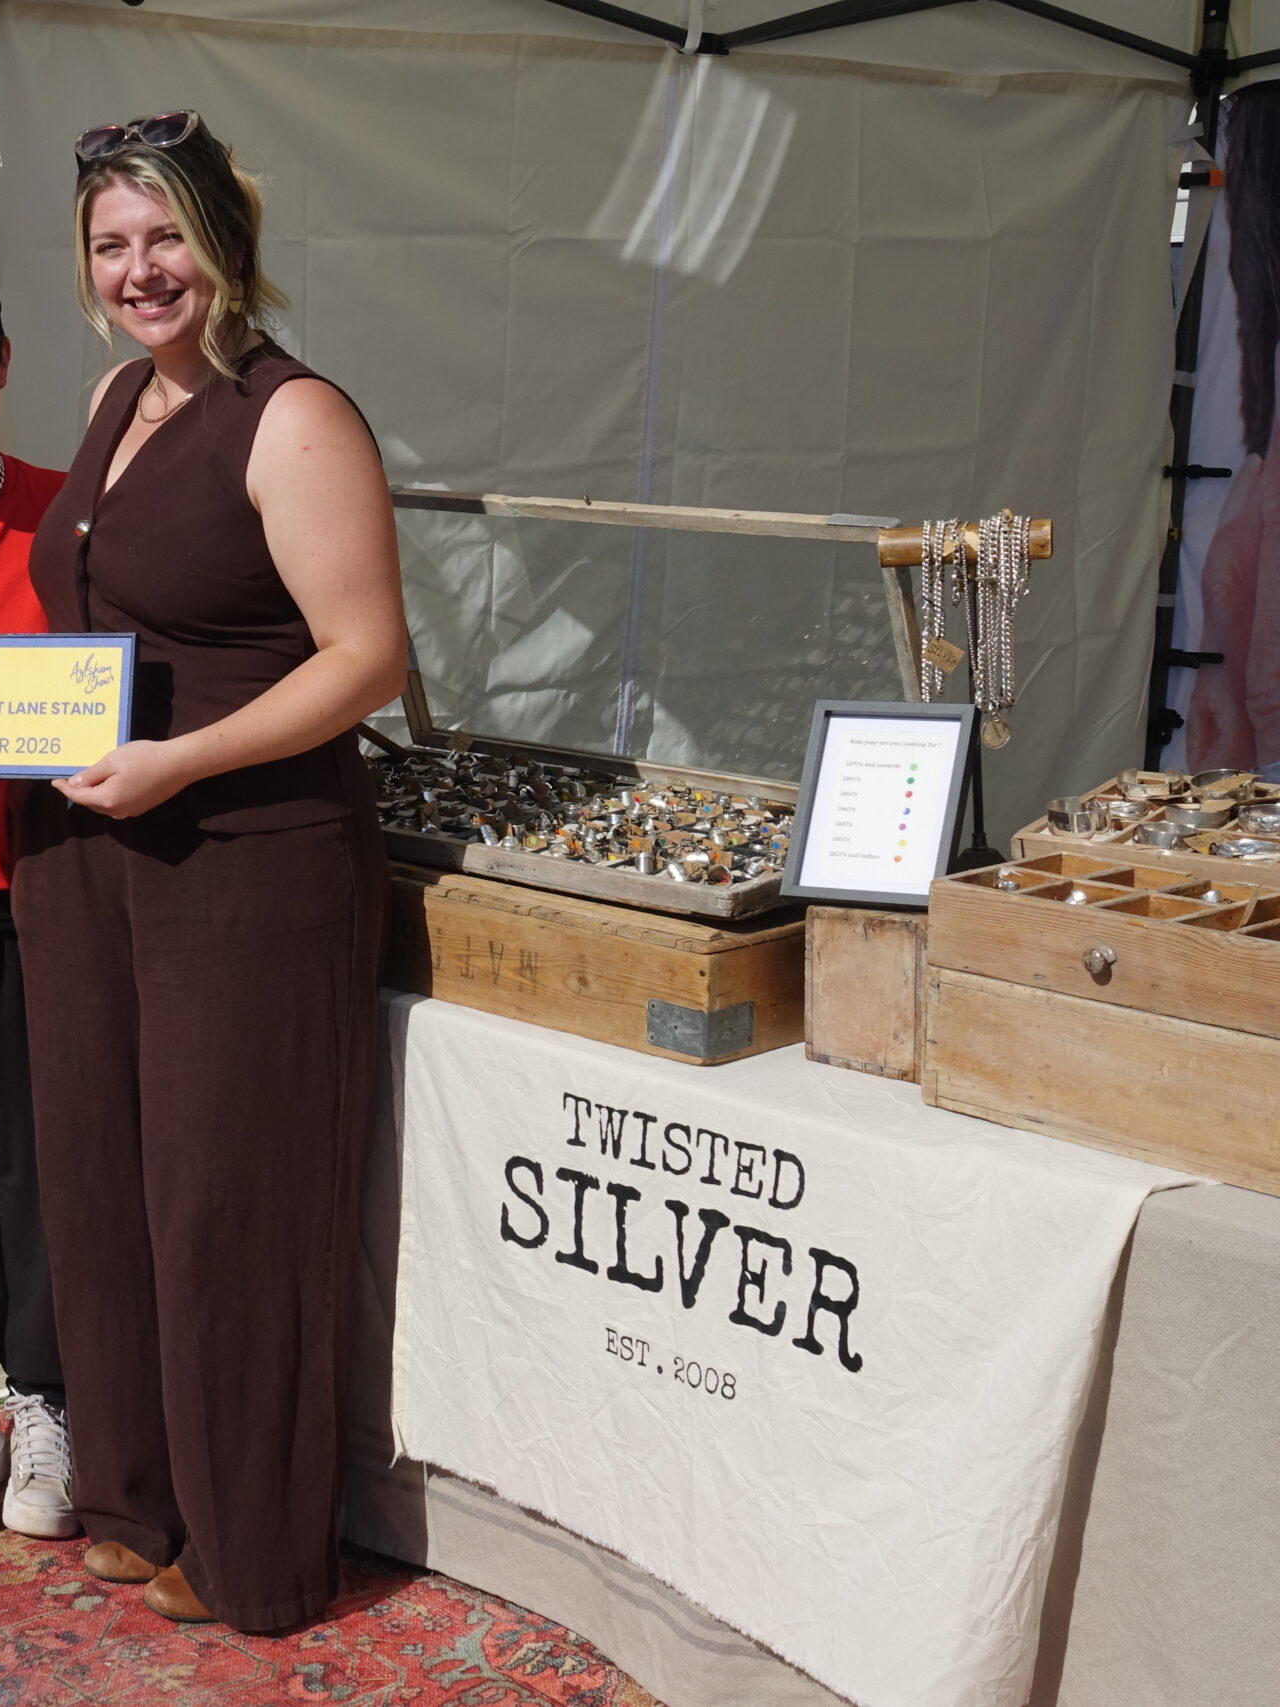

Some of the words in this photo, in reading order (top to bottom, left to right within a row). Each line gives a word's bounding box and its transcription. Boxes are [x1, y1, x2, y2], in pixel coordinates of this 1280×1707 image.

[7, 701, 48, 715] LANE
[51, 701, 106, 716] STAND
[14, 737, 62, 755] 2026
[563, 1091, 805, 1210] TWISTED
[500, 1155, 863, 1373] SILVER
[605, 1326, 737, 1400] EST.2008
